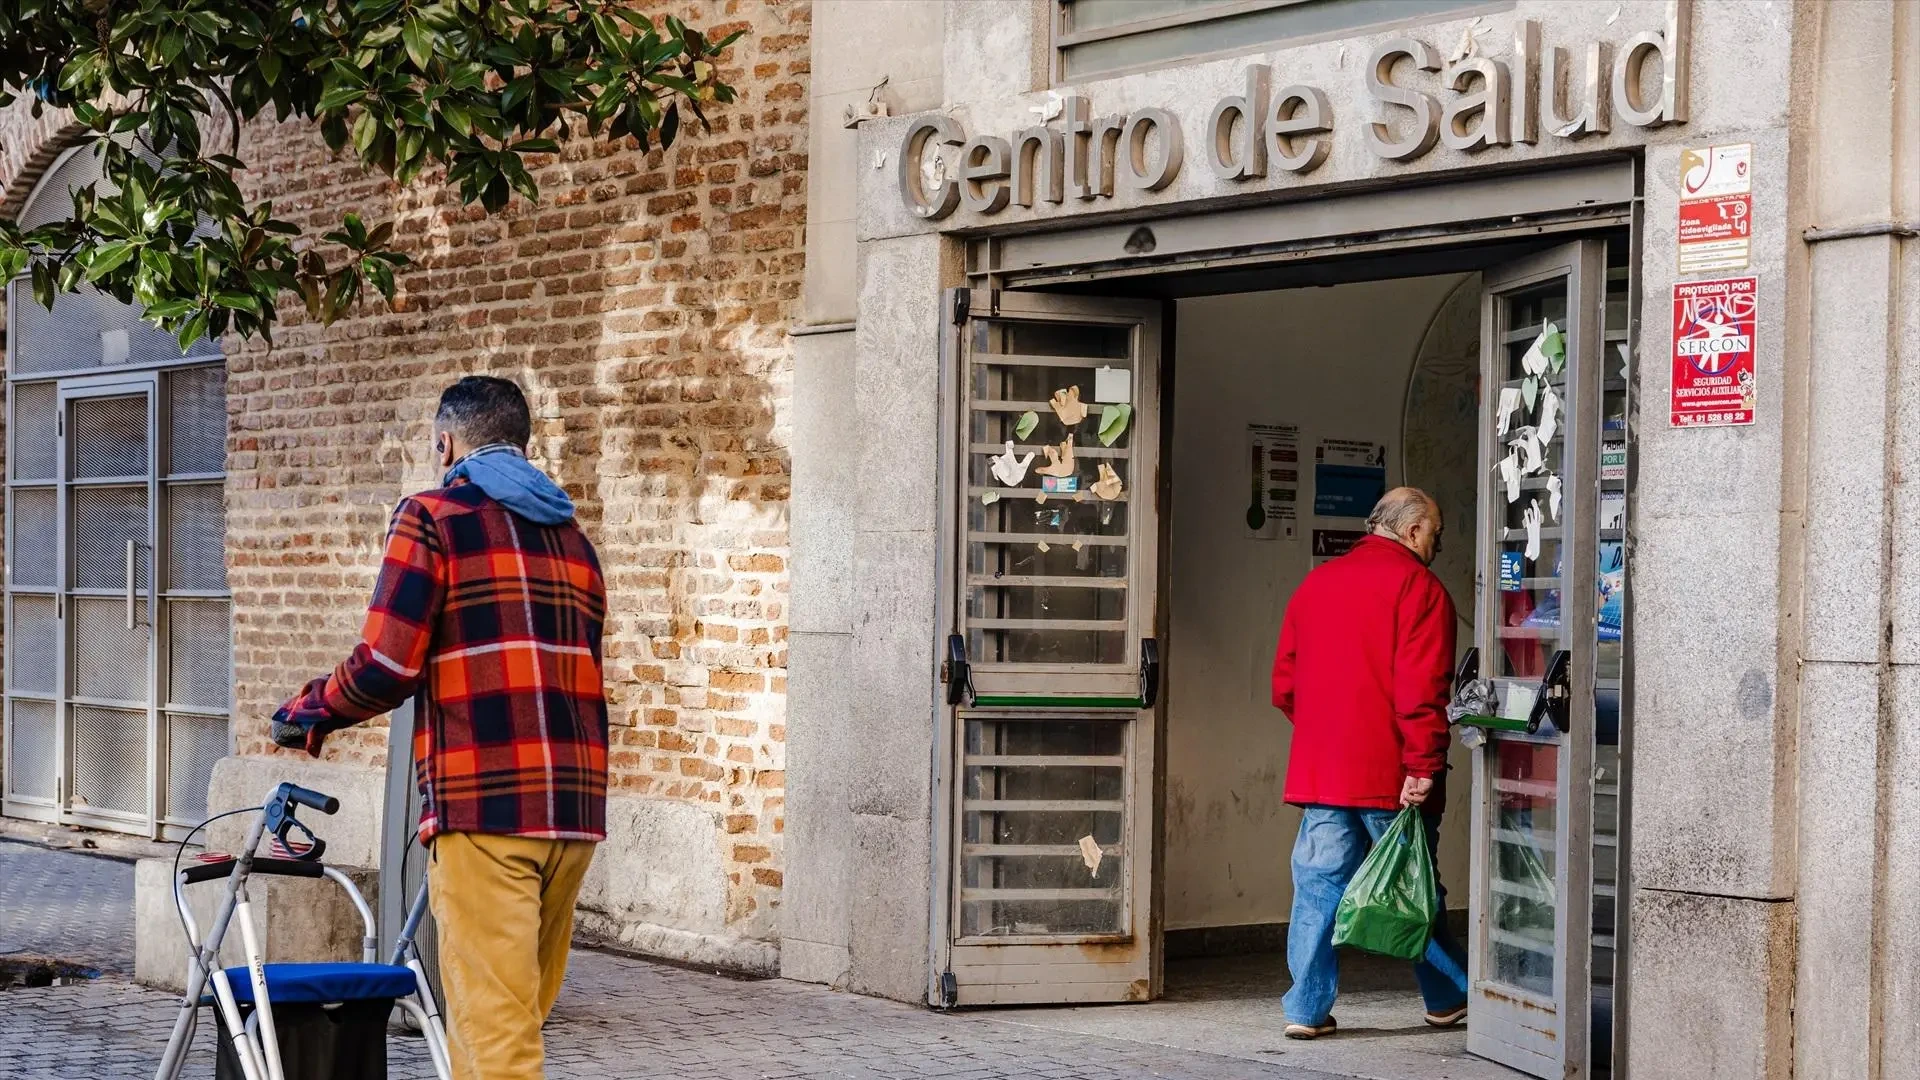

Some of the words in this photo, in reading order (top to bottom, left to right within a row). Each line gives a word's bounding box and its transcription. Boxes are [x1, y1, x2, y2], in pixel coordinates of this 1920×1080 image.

[899, 95, 1184, 219] Centro
[1206, 63, 1333, 180] de
[1363, 0, 1692, 160] Salud
[1681, 219, 1700, 227] Zona
[1679, 283, 1730, 296] PROTEGIDO
[1732, 282, 1751, 291] POR
[1680, 336, 1747, 354] SERCON
[1693, 376, 1732, 387] SEGURIDAD
[1676, 387, 1710, 397] SERVICIOS
[1696, 414, 1706, 422] 91
[1735, 412, 1745, 420] 22
